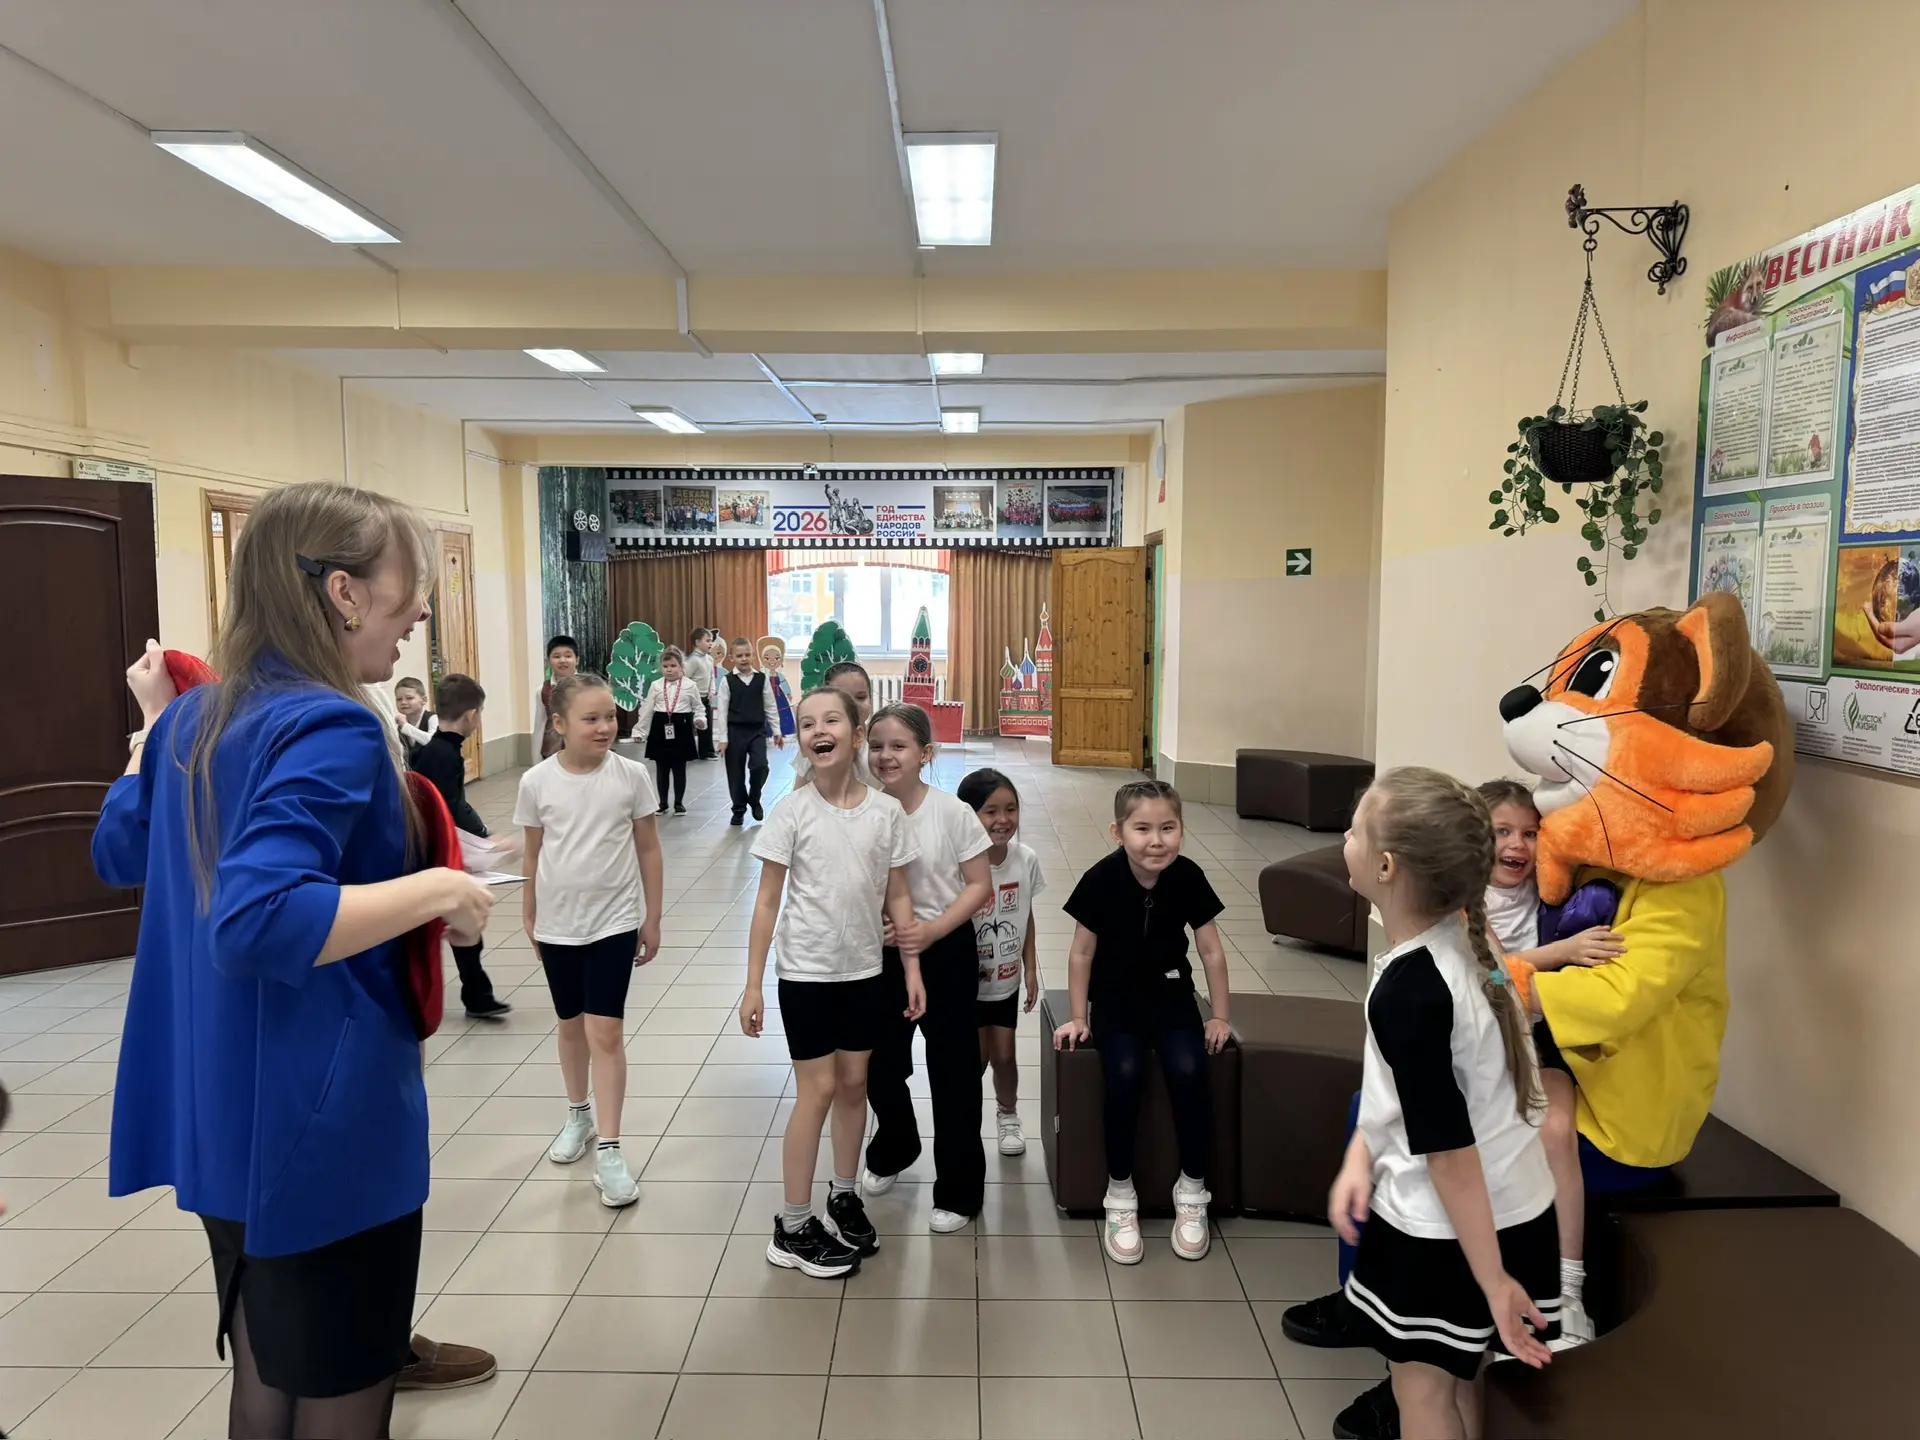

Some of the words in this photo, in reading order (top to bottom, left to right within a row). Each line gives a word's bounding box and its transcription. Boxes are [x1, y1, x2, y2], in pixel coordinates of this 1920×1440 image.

[1764, 200, 1911, 291] ВЕСТНИК
[876, 505, 895, 514] ГОД
[1769, 502, 1796, 513] Природа
[772, 510, 828, 532] 2026
[876, 514, 926, 522] ЕДИНСТВА
[876, 522, 921, 530] НАРОДОВ
[876, 530, 916, 538] РОССИИ
[1854, 680, 1910, 695] Экологические
[1858, 714, 1883, 725] ЛИСТОК
[1855, 721, 1878, 732] ЖИЗНИ
